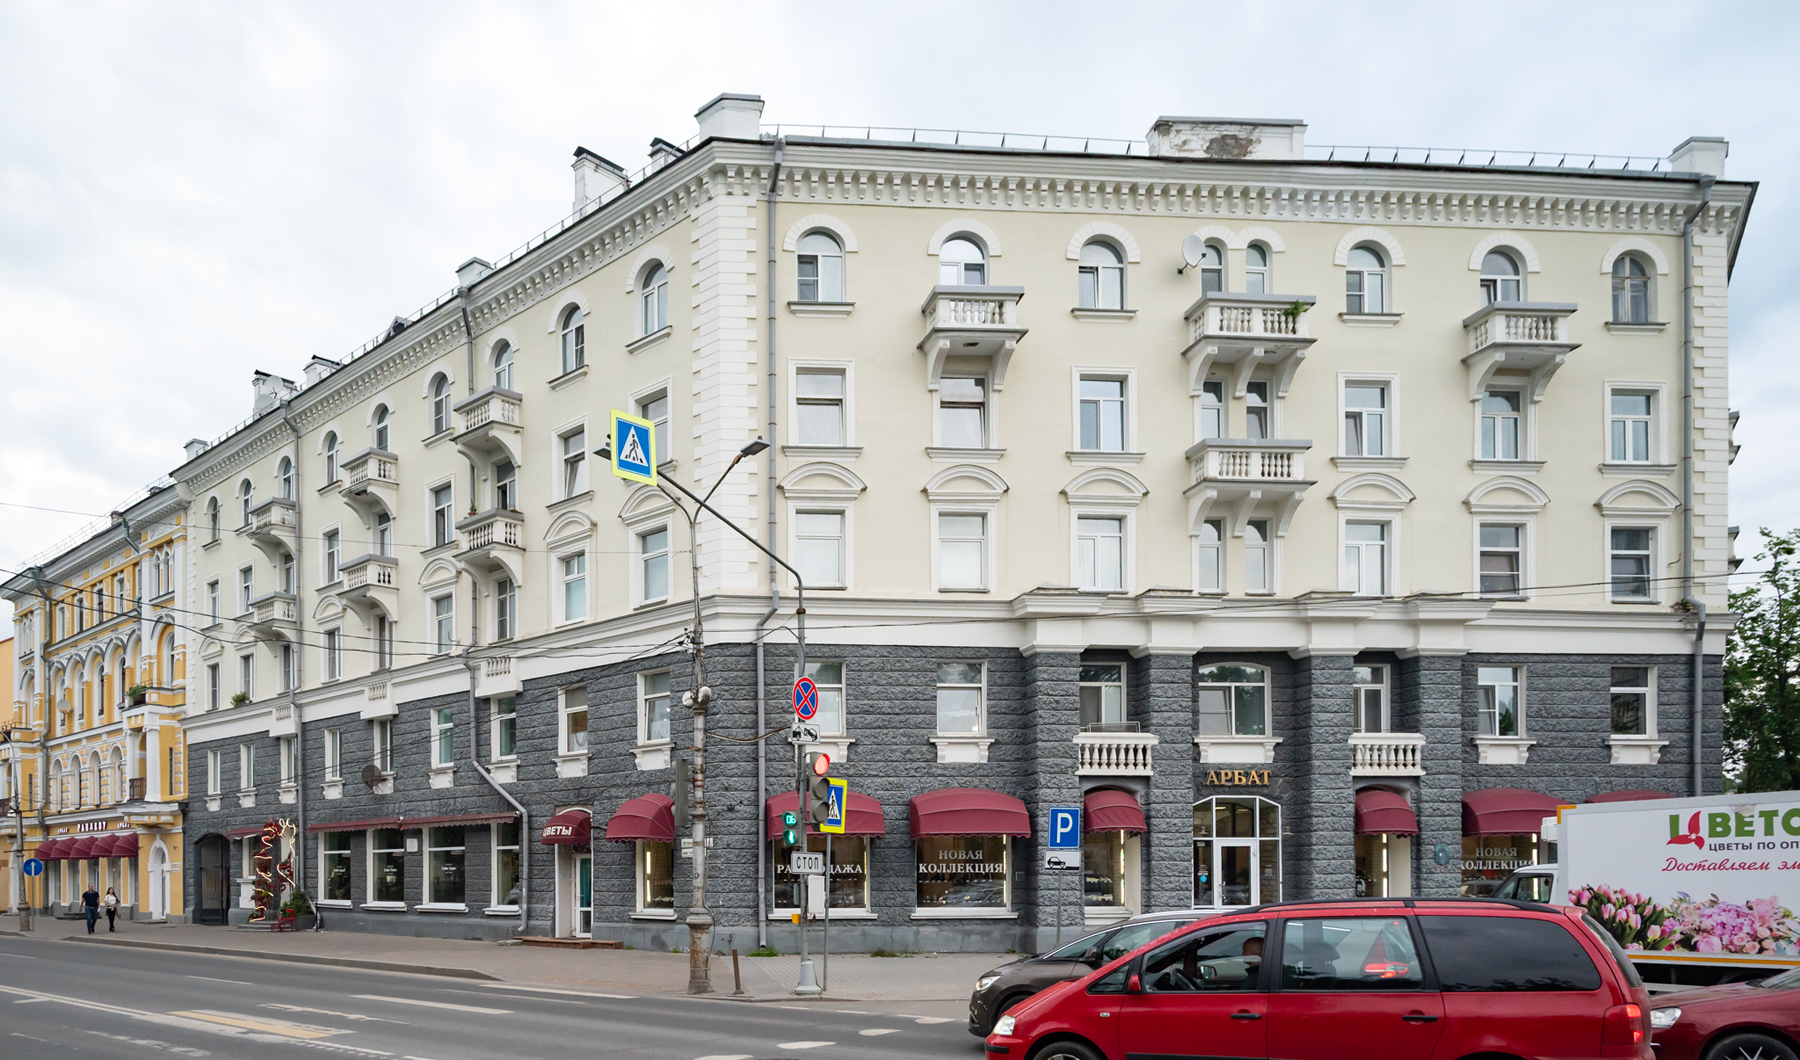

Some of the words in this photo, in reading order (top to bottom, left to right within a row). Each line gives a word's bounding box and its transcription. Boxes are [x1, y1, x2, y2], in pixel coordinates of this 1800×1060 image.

[1205, 769, 1272, 785] АРБАТ
[542, 825, 573, 838] ЦВЕТЫ
[1056, 812, 1073, 844] P
[1475, 847, 1518, 857] НОВАЯ
[1709, 842, 1752, 852] ЦВЕТЫ
[1757, 841, 1776, 850] ПО
[938, 849, 984, 860] НОВАЯ
[796, 856, 819, 870] СТОП
[918, 863, 1004, 875] КОЛЛЕКЦИЯ
[1661, 857, 1771, 872] Доставляем
[776, 864, 863, 875] РАДАЖА
